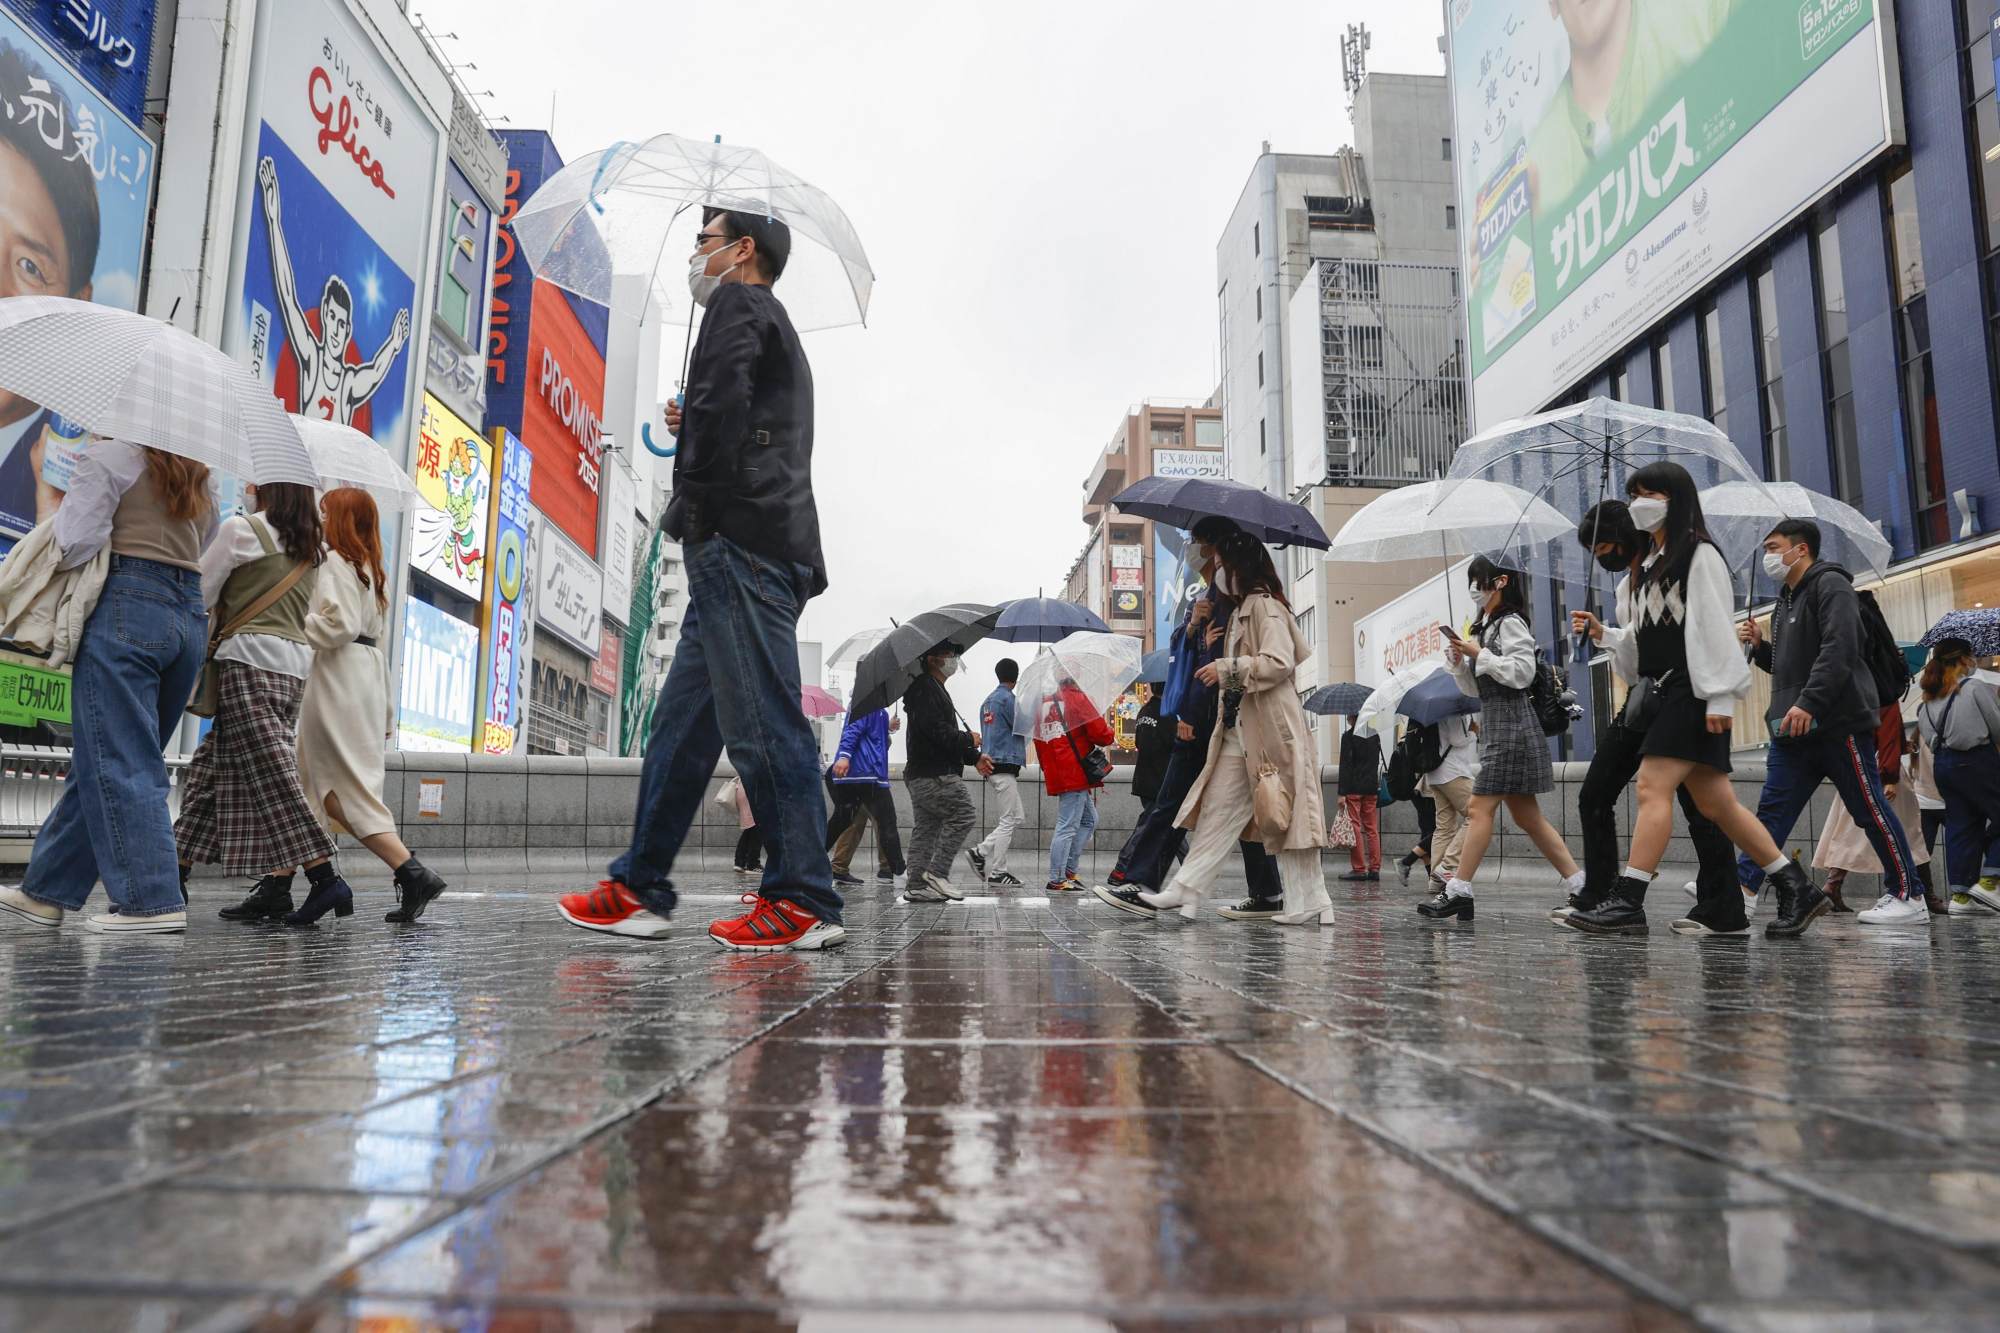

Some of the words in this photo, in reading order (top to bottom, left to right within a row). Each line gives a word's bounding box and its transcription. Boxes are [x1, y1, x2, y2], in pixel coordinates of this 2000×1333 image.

[308, 66, 395, 200] Glico
[1480, 181, 1527, 252] サロンパス
[1550, 97, 1694, 291] サロンパス
[540, 346, 605, 463] PROMISE
[1384, 620, 1441, 670] なの花薬局
